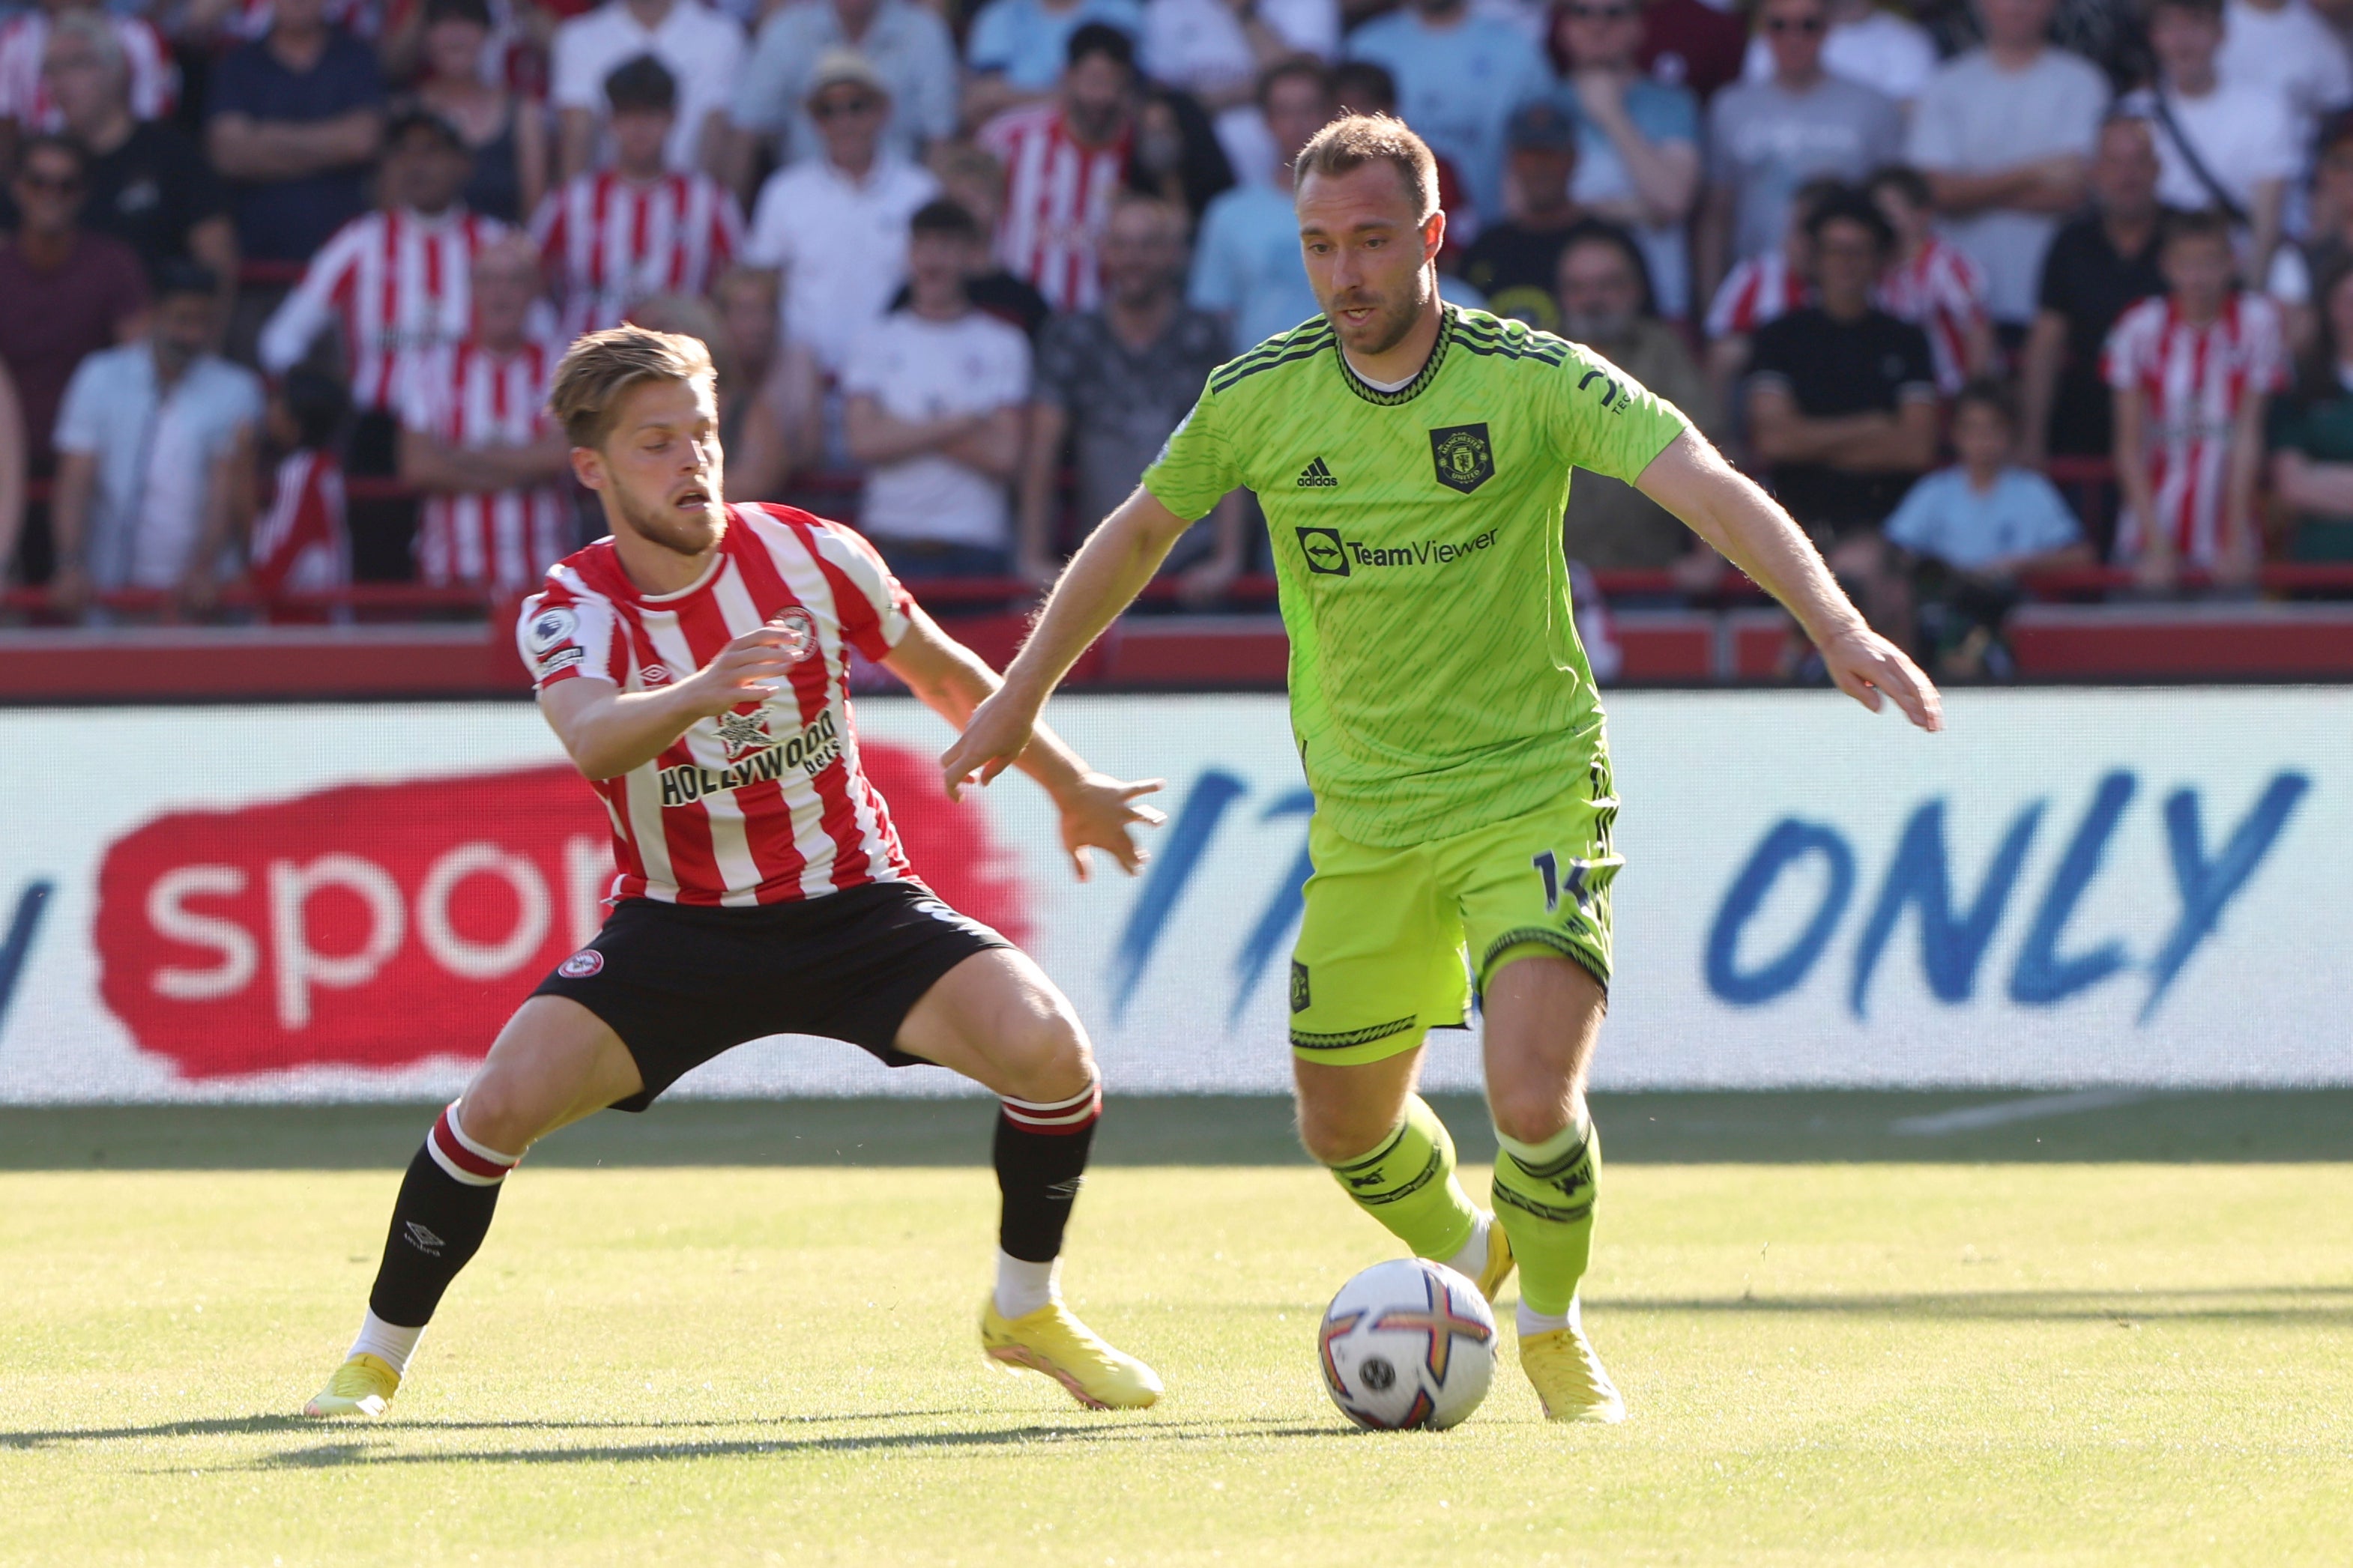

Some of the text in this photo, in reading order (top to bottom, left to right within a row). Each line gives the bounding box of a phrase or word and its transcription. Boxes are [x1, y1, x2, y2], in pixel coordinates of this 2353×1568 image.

[1441, 435, 1481, 455] MANCHESTER
[1297, 476, 1338, 487] adidas
[1452, 469, 1480, 480] UNITED
[1346, 528, 1498, 567] TeamViewer
[661, 709, 835, 805] HOLLYWOOD
[803, 739, 842, 775] bets
[1701, 764, 2311, 1026] ONLY
